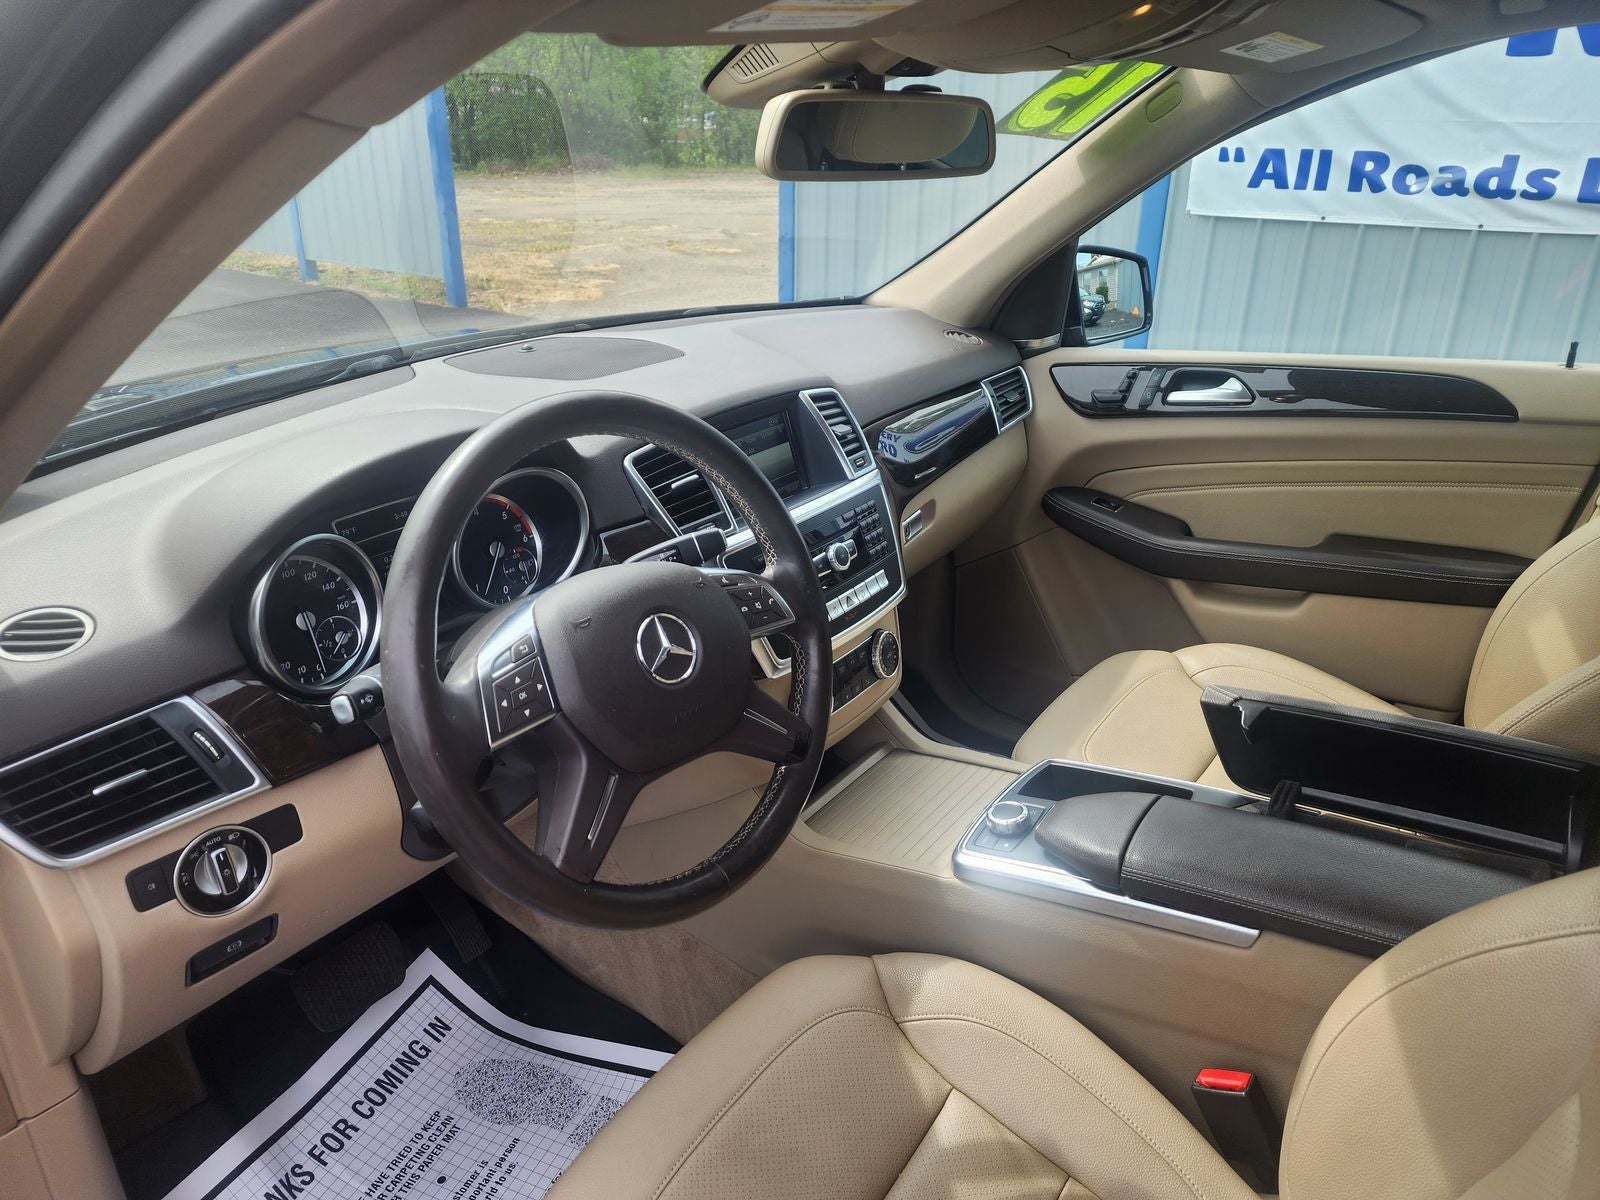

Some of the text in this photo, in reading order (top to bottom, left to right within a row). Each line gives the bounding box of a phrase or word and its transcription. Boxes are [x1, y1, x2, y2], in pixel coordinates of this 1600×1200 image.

[1347, 150, 1561, 201] Roads
[502, 511, 508, 520] 5
[522, 533, 528, 543] 6
[281, 568, 296, 579] 100
[303, 570, 317, 581] 120
[322, 581, 336, 592] 140
[503, 585, 509, 595] 0
[336, 600, 350, 611] 160
[297, 665, 307, 675] 10
[518, 690, 528, 700] OK
[206, 836, 221, 847] AUTO
[307, 1118, 360, 1167] FOR
[351, 1039, 432, 1120] COMING
[423, 1015, 453, 1043] IN
[365, 1110, 441, 1197] HAVE TRIED TO KEEP
[385, 1142, 431, 1193] CARPETING
[427, 1115, 455, 1143] CLEAN
[495, 1137, 521, 1168] person
[397, 1173, 421, 1194] THIS
[417, 1144, 446, 1172] PAPER
[441, 1123, 461, 1143] MAT
[476, 1160, 489, 1170] is
[494, 1176, 507, 1186] to
[504, 1161, 519, 1175] us.
